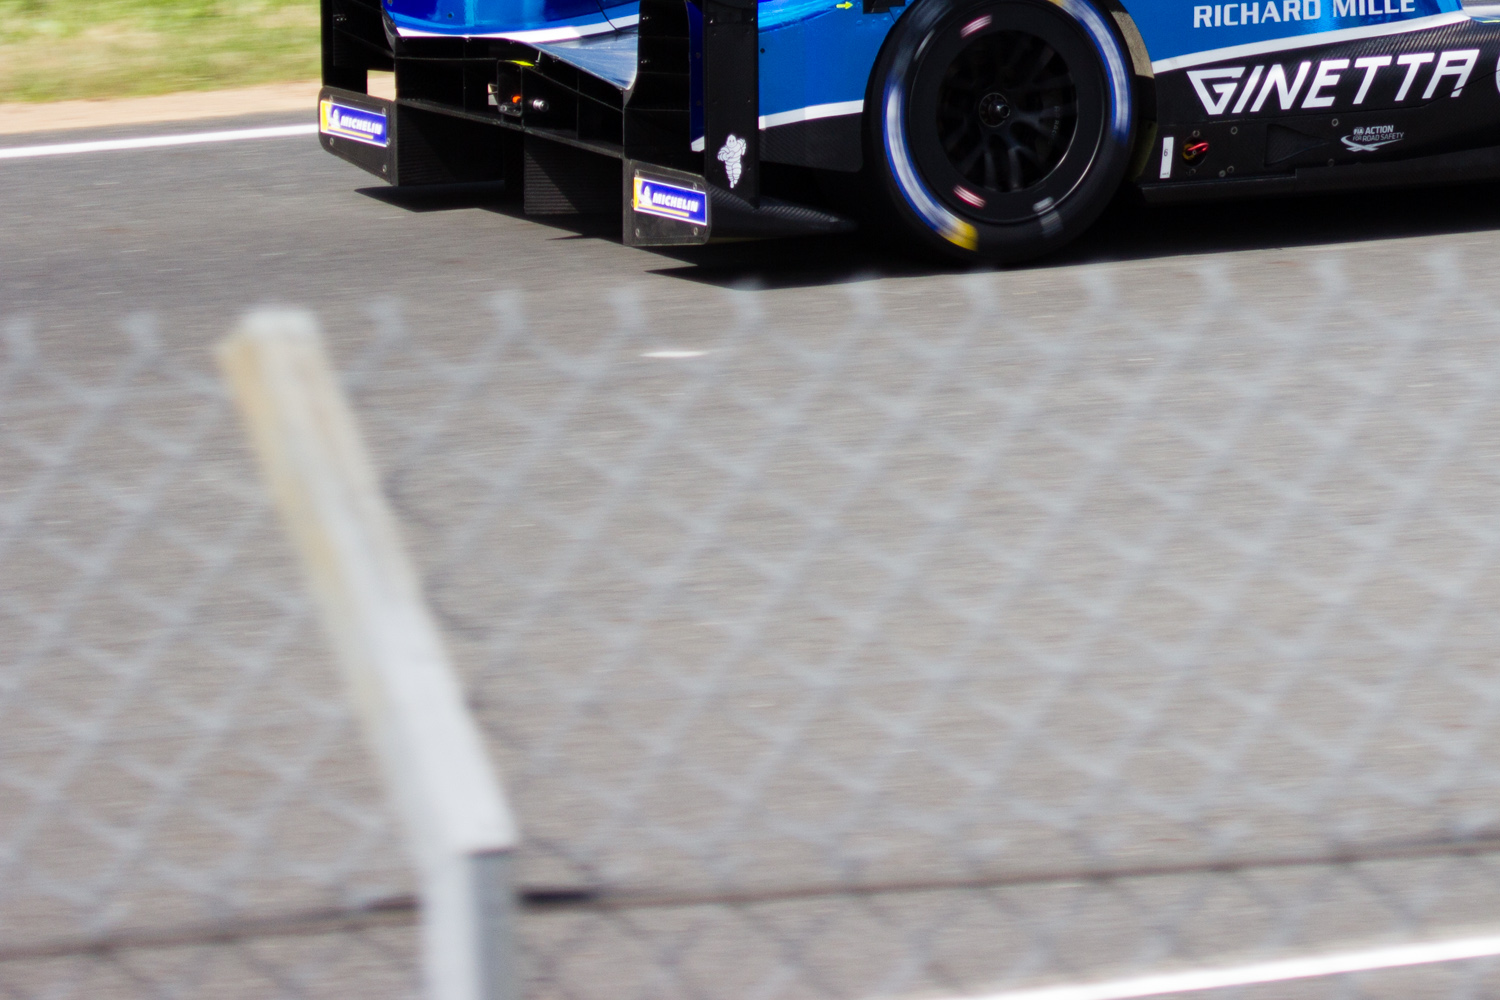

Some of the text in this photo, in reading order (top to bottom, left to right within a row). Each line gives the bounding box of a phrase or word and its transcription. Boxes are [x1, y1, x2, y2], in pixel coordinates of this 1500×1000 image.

[1186, 49, 1480, 116] GINETTA
[341, 115, 383, 135] MICHELIN
[1365, 125, 1394, 135] ACTION
[1363, 134, 1380, 142] ROAD
[1381, 132, 1405, 140] SAFETY
[652, 192, 699, 213] MICHELIN
